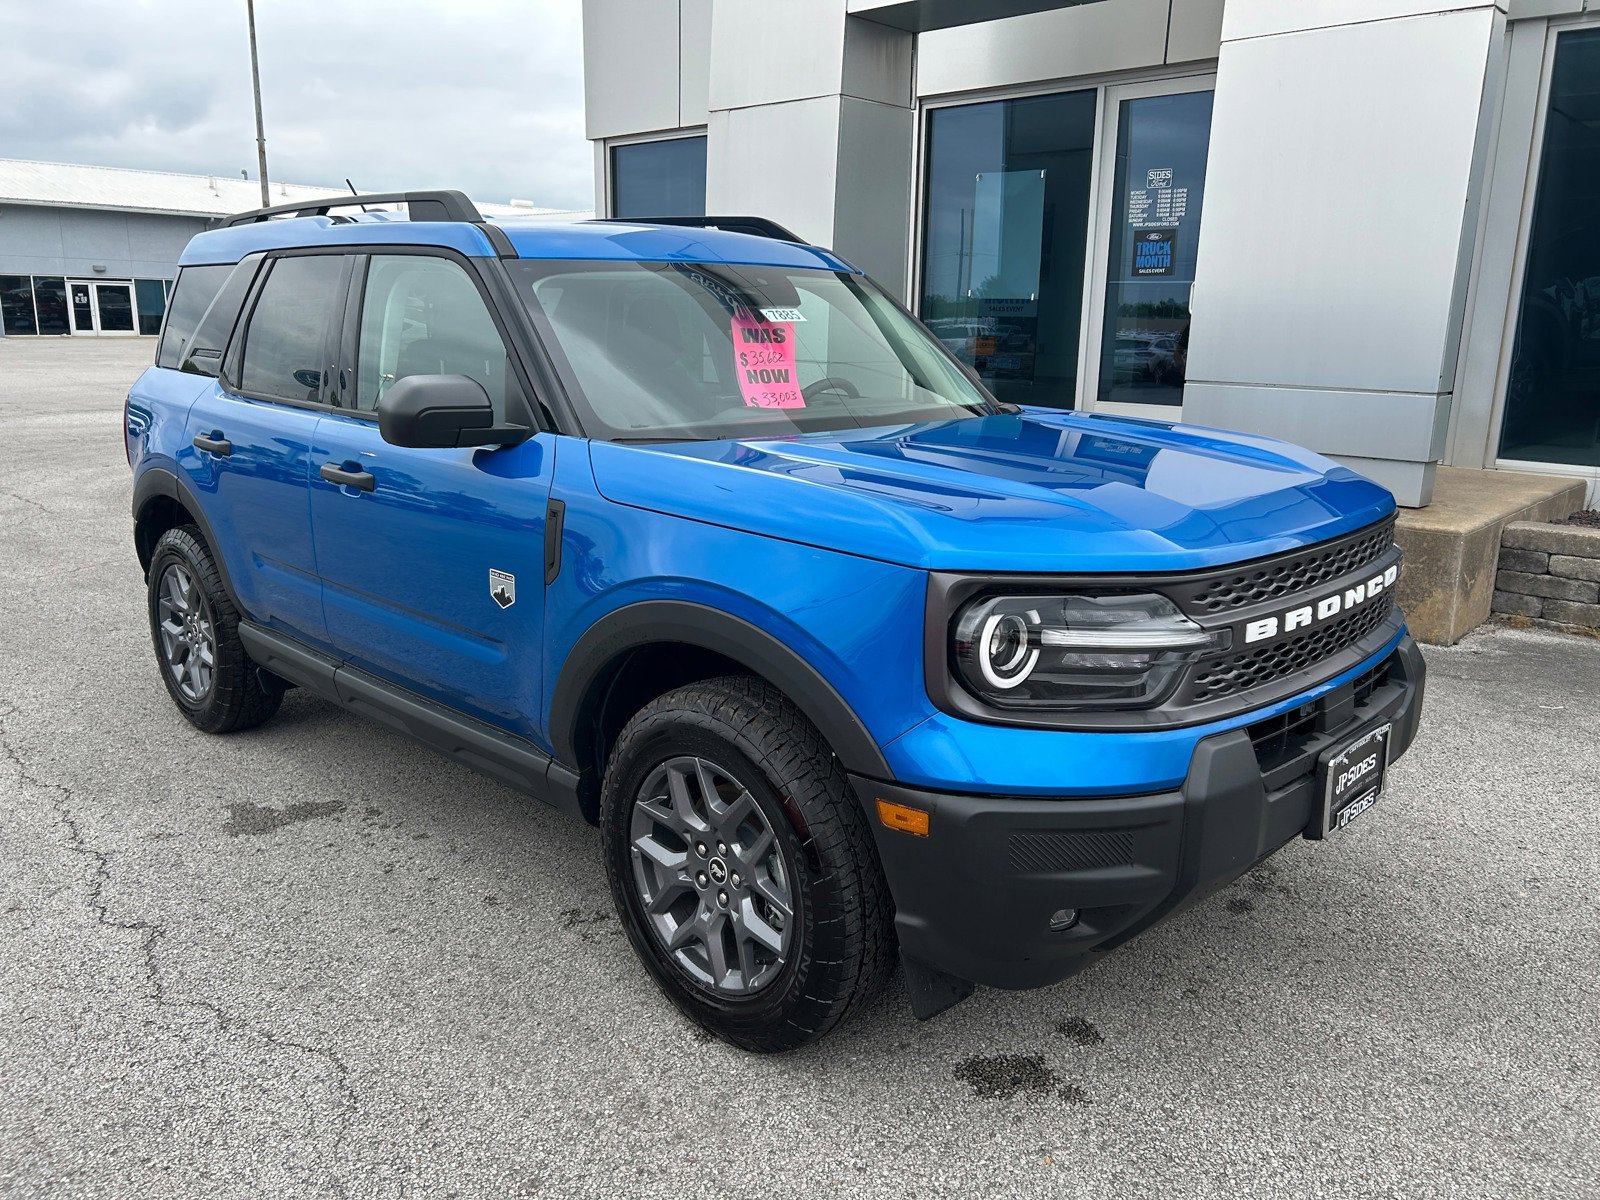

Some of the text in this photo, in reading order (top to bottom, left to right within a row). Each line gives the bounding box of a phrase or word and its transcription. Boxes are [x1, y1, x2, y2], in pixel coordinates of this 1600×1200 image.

[1149, 171, 1171, 180] SIDES
[1151, 179, 1168, 187] Ford
[1136, 241, 1171, 255] TRUCK
[1136, 255, 1171, 268] MONTH
[741, 328, 786, 344] WAS
[740, 352, 749, 367] $
[746, 369, 790, 384] NOW
[1245, 565, 1398, 643] BRONCO
